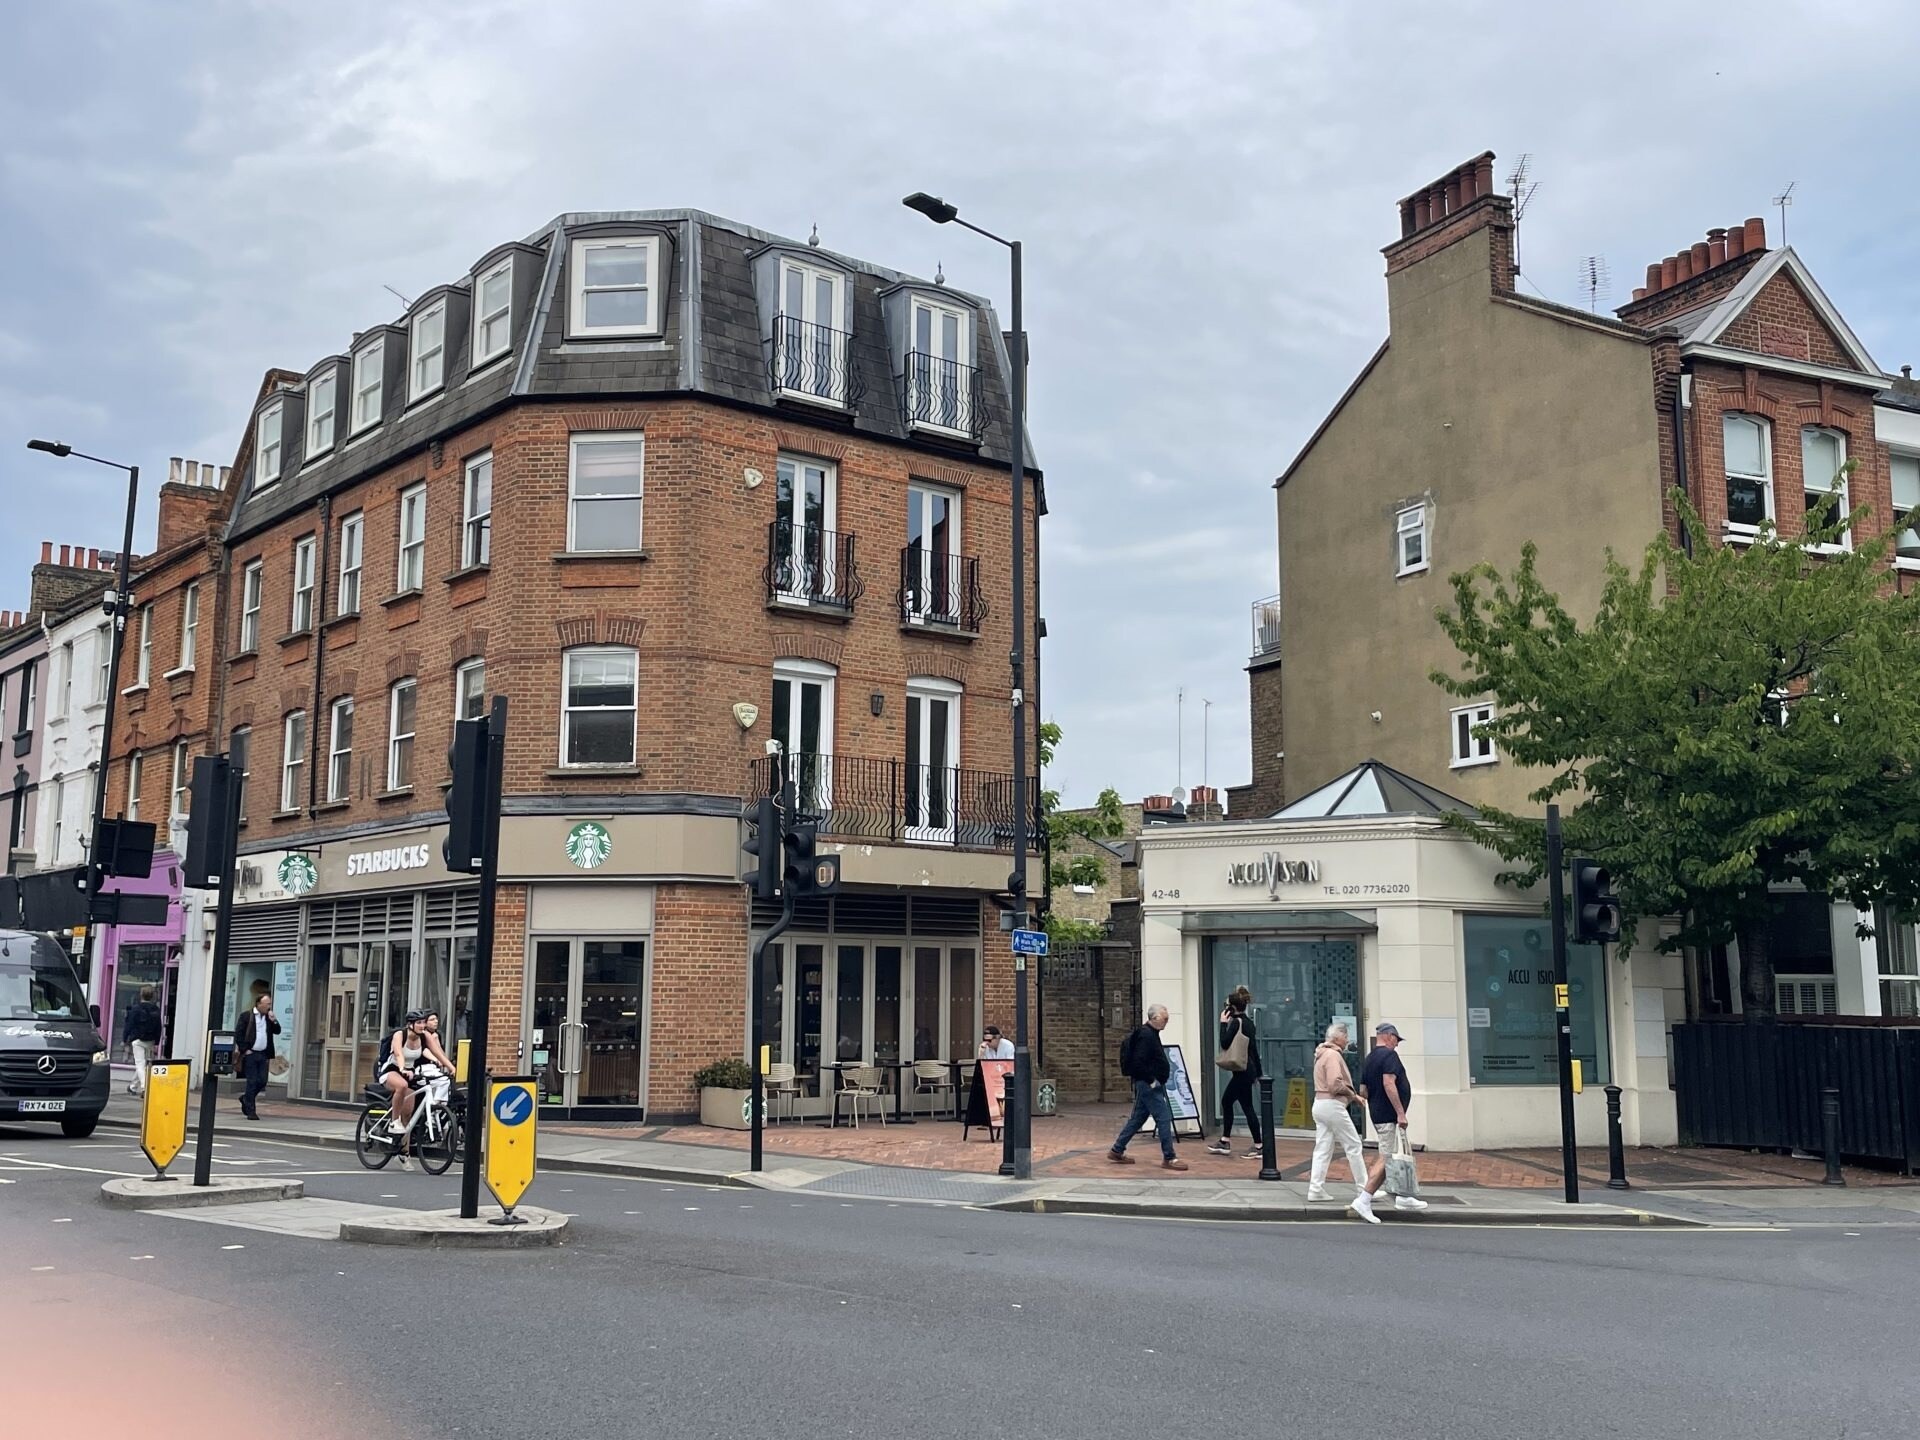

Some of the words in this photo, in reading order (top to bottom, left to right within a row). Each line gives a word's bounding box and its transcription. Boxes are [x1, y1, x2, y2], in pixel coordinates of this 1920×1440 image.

[346, 844, 428, 876] STARBUCKS
[1151, 889, 1180, 900] 42-48
[1342, 885, 1360, 895] 020
[1363, 884, 1410, 894] 77362020
[24, 1101, 46, 1110] RX74
